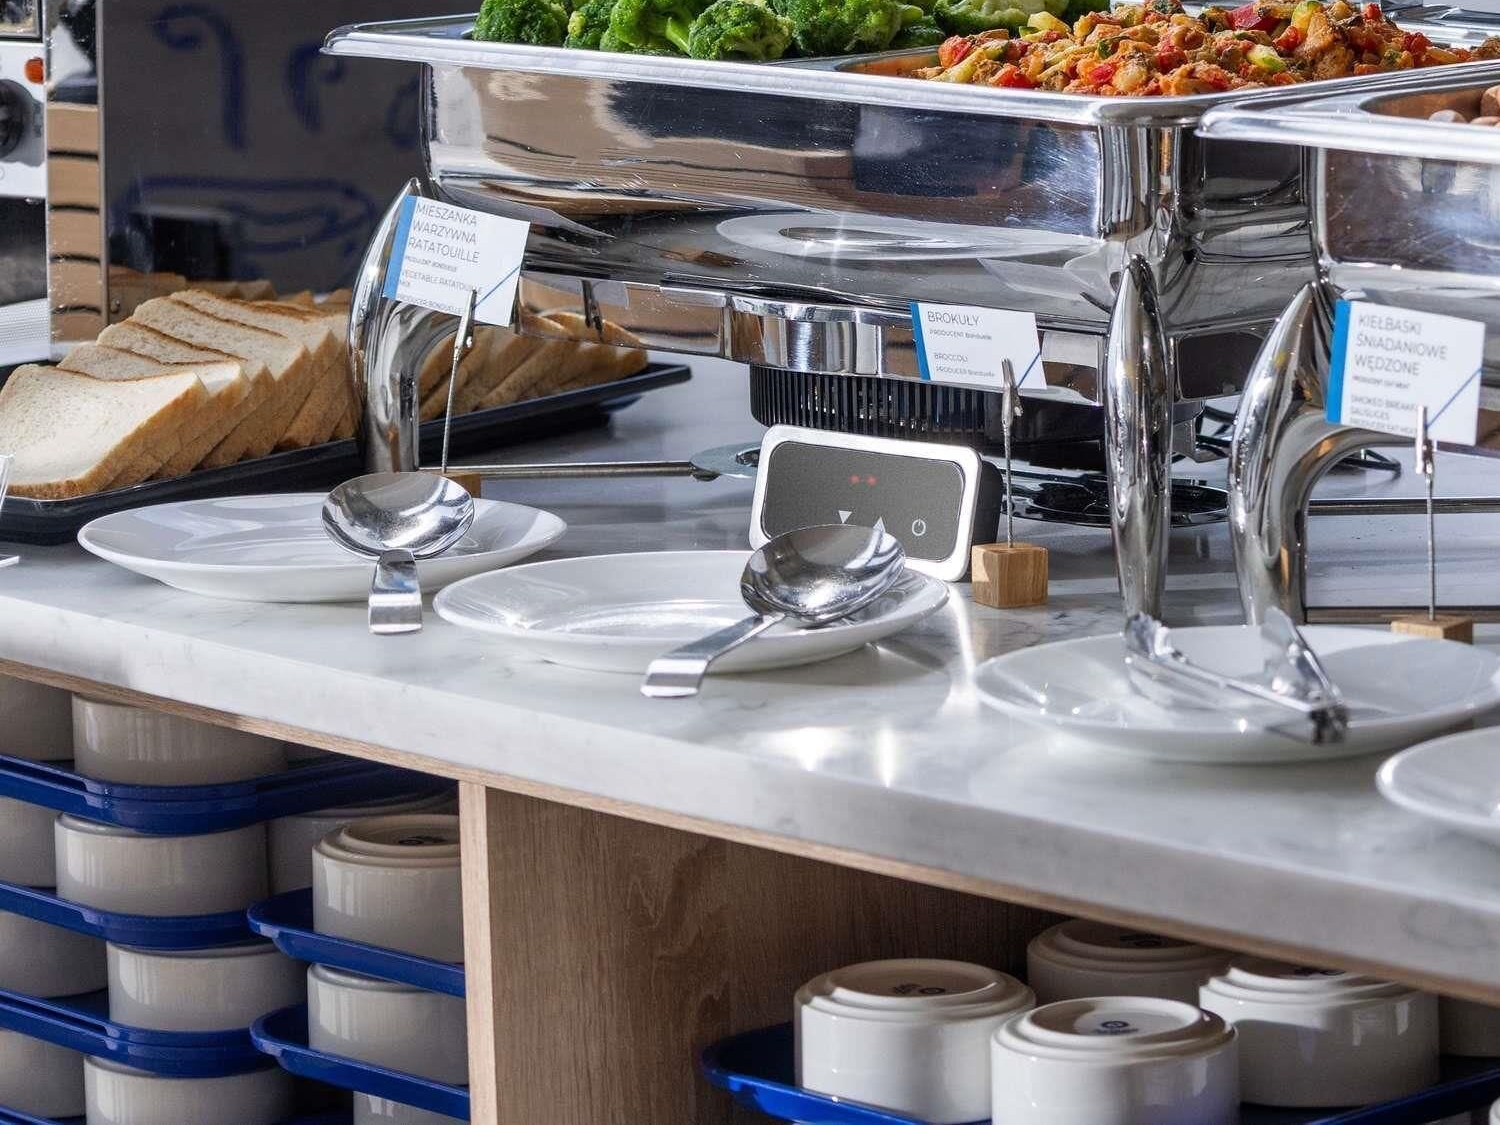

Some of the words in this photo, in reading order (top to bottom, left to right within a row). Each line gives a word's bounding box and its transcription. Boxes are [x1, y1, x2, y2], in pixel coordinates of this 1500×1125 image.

[416, 203, 477, 225] MIESZANKA
[412, 219, 477, 244] WARZYWNA
[408, 237, 480, 263] RATATOUILLE
[1355, 333, 1448, 360] ŚNIADANIOWE
[1354, 354, 1421, 376] WĘDZONE
